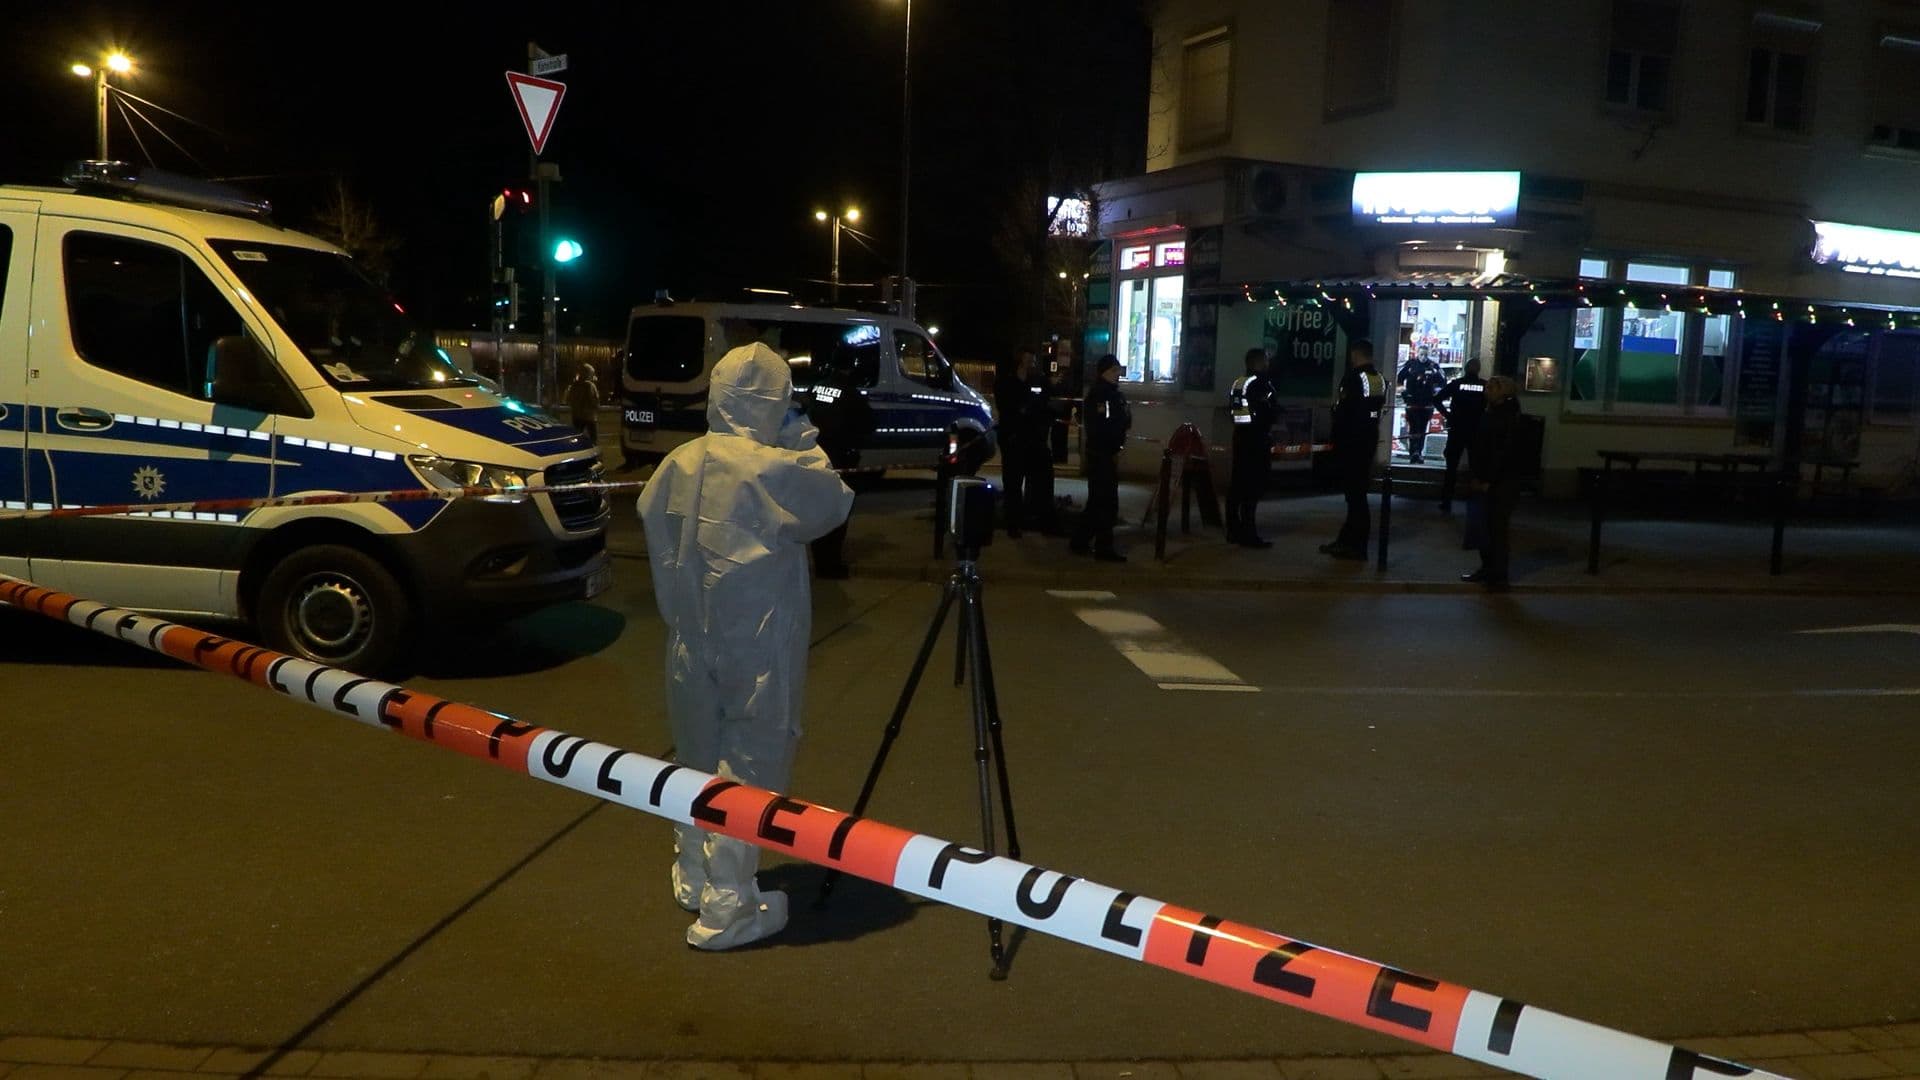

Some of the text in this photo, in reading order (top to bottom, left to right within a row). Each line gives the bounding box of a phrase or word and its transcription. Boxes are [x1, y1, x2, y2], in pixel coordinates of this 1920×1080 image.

[1292, 337, 1334, 367] to go
[811, 384, 843, 399] POLIZEI
[624, 409, 655, 423] POLIZEI
[927, 842, 1524, 1057] POLIZEI
